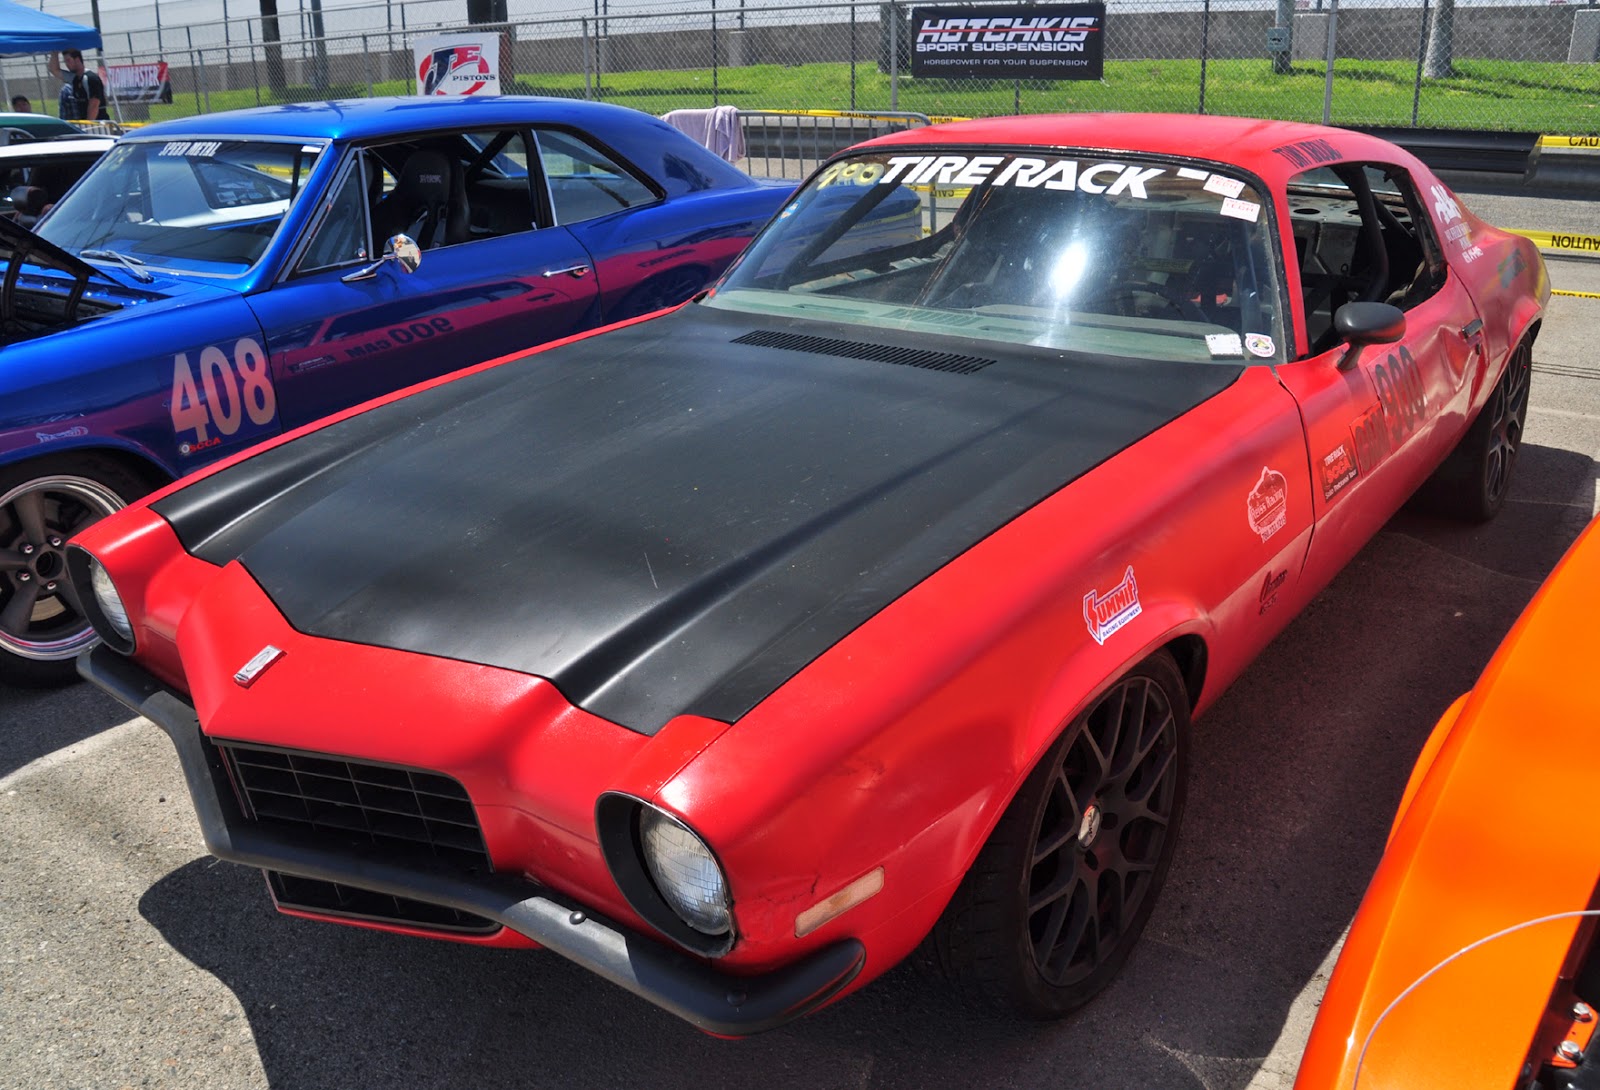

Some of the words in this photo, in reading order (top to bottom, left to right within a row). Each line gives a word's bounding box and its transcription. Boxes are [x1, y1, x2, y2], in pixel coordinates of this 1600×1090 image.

[916, 17, 1094, 42] HOTCHKIS
[916, 42, 968, 52] SPORT
[972, 42, 1084, 52] SUSPENSION
[923, 58, 981, 66] HORSEPOWER
[983, 58, 1000, 66] FOR
[1002, 58, 1027, 66] YOUR
[1029, 58, 1088, 67] SUSPENSION
[184, 141, 223, 157] METAL
[171, 338, 276, 443] 408
[1375, 345, 1426, 444] 900
[189, 437, 222, 453] SCCA
[1102, 622, 1119, 638] RACING
